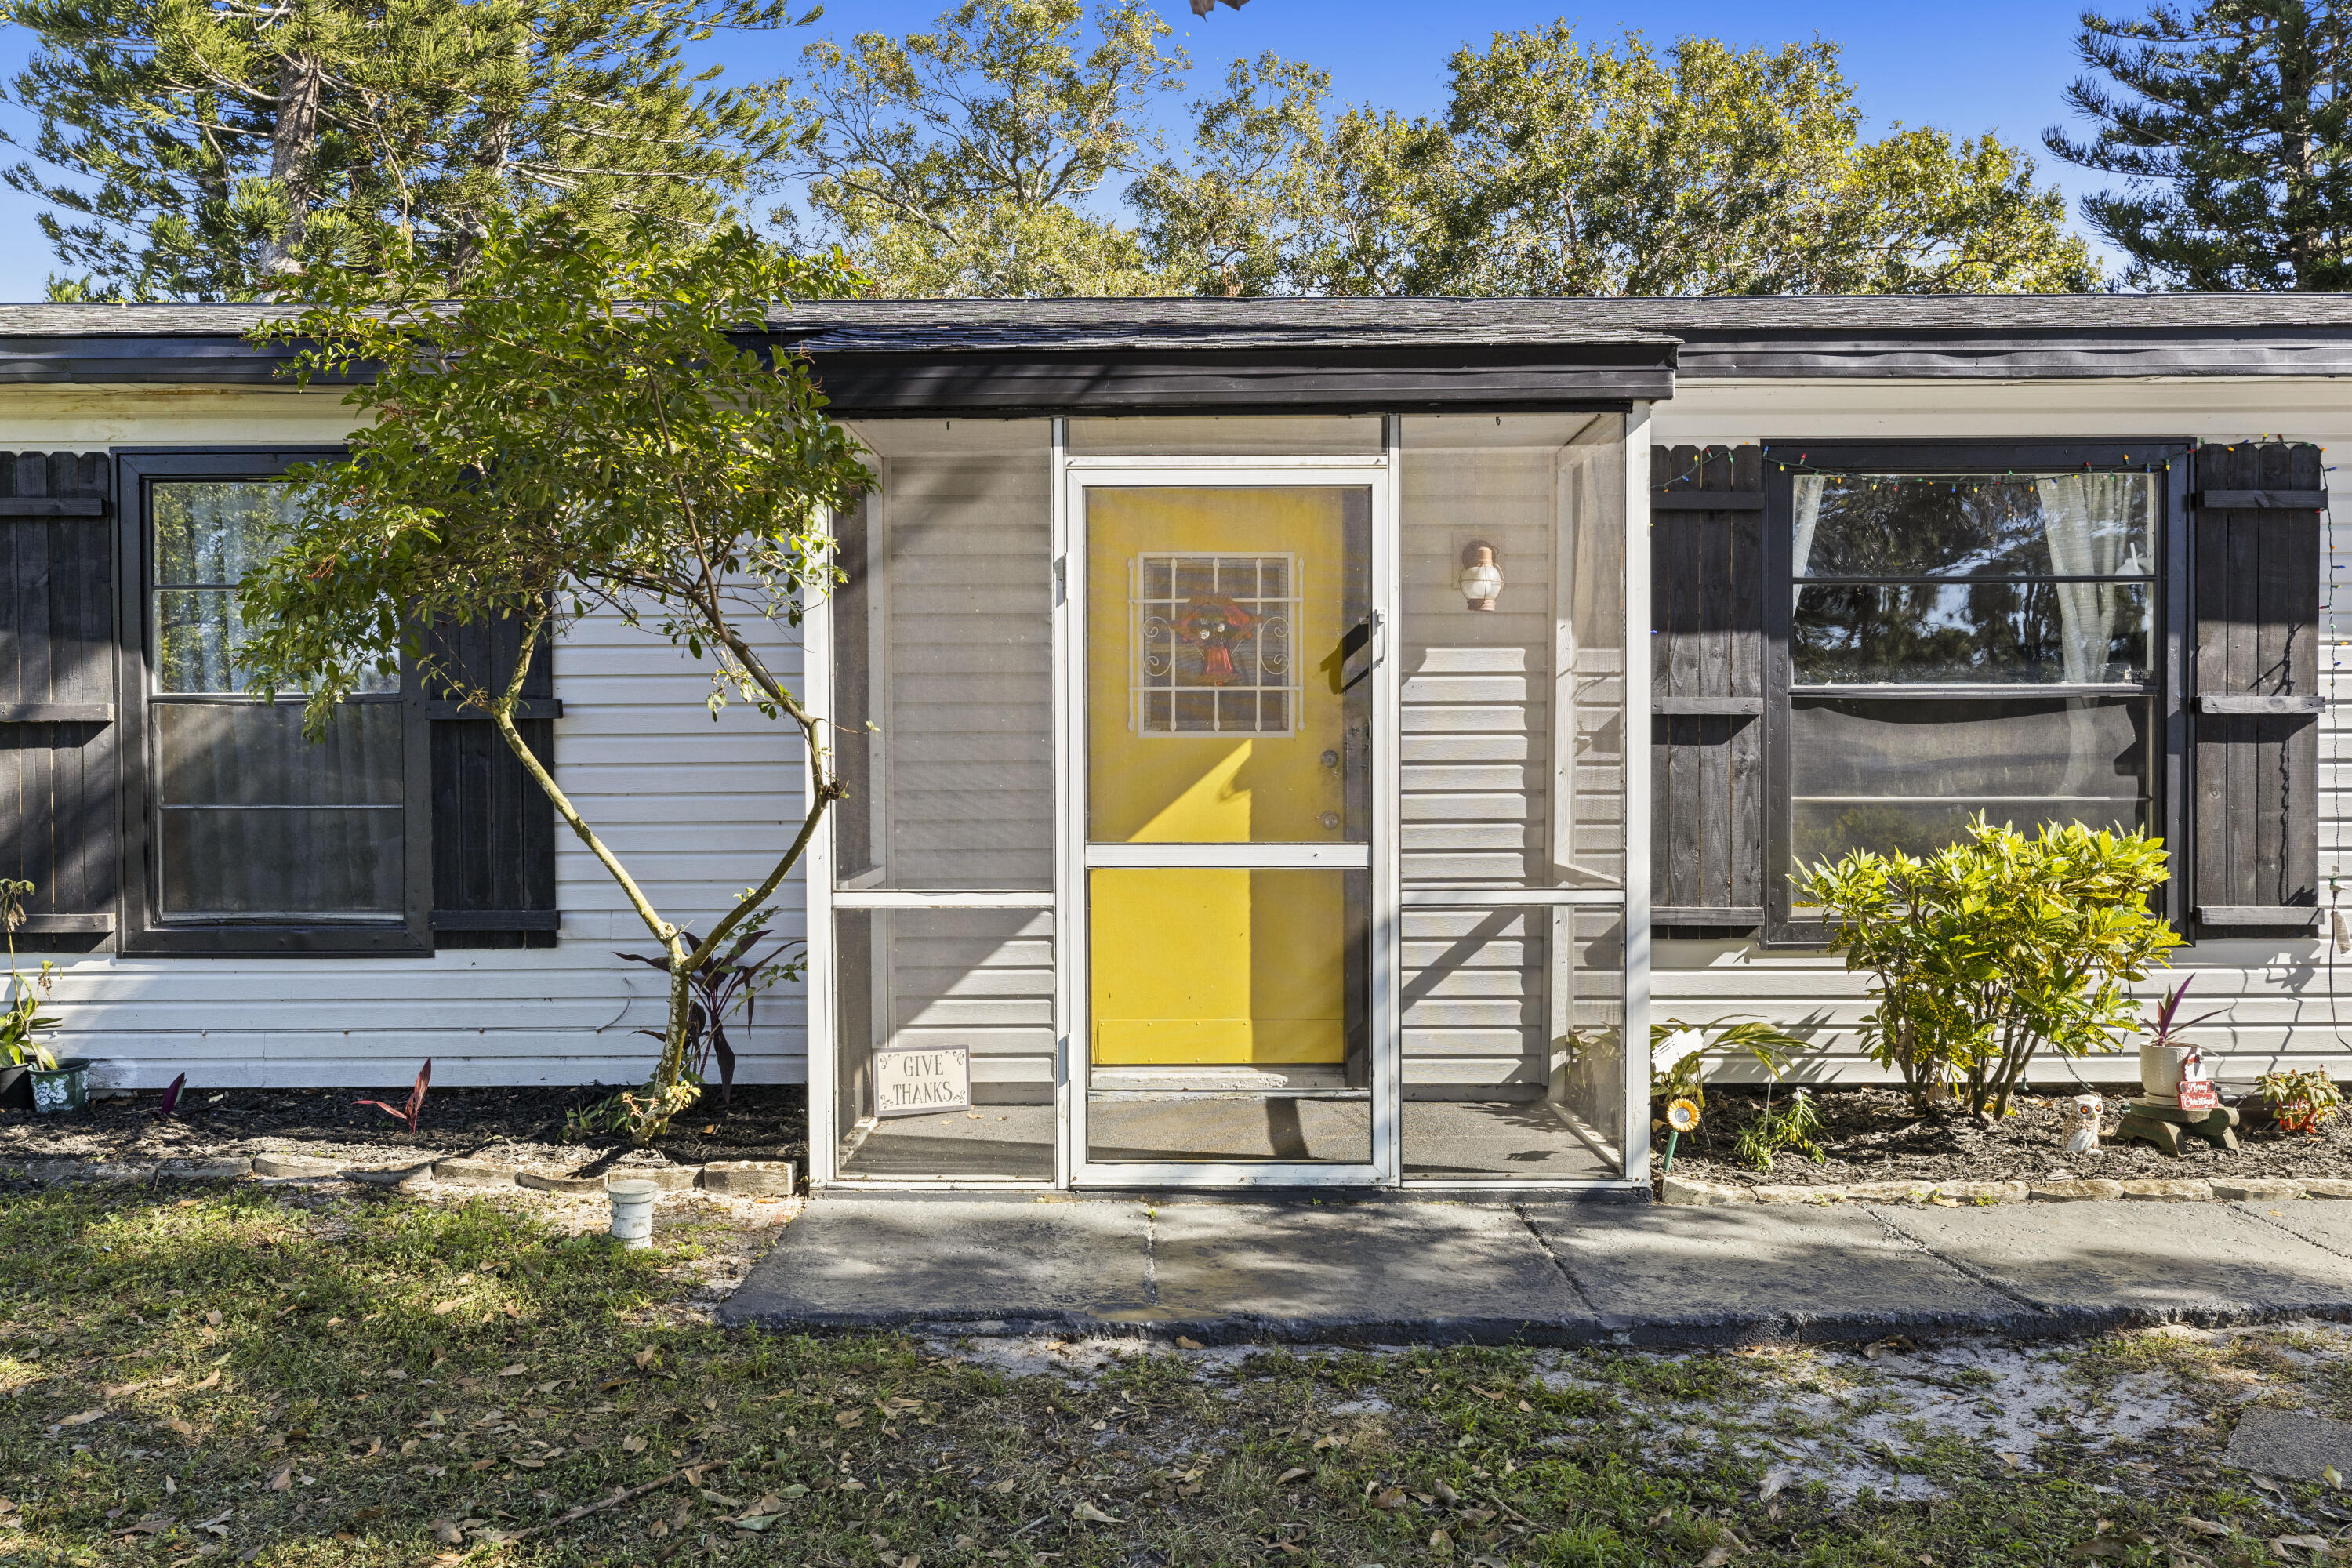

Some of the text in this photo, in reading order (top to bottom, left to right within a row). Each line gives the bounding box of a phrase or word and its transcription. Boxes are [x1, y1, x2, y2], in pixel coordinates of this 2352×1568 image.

[903, 1054, 943, 1076] GIVE
[892, 1081, 953, 1105] THANKS
[2187, 1082, 2208, 1094] Merry
[2184, 1096, 2216, 1108] Christmas
